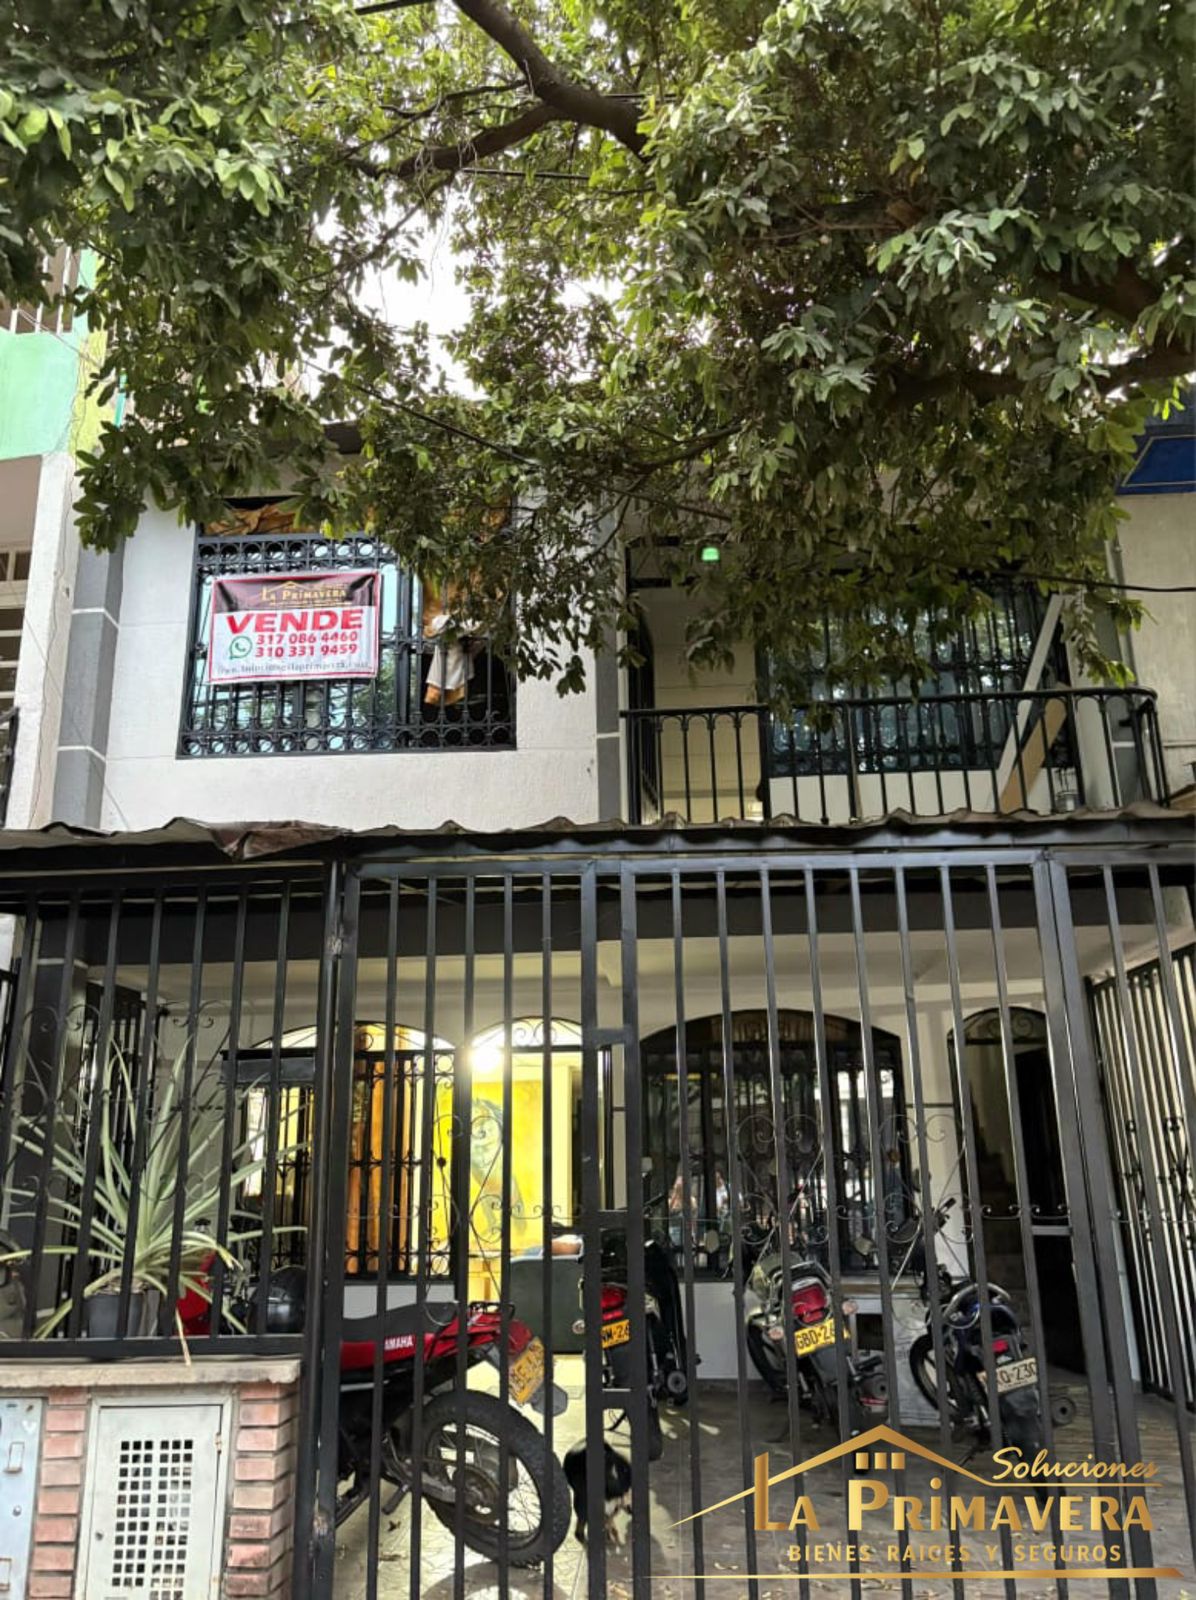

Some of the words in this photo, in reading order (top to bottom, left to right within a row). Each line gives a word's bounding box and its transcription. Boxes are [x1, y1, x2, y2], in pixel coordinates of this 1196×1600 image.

[226, 609, 364, 634] VENDE
[256, 633, 285, 645] 317
[288, 632, 317, 644] 086
[320, 631, 358, 643] 4460
[255, 646, 284, 658] 310
[288, 645, 315, 657] 331
[320, 643, 358, 656] 9459
